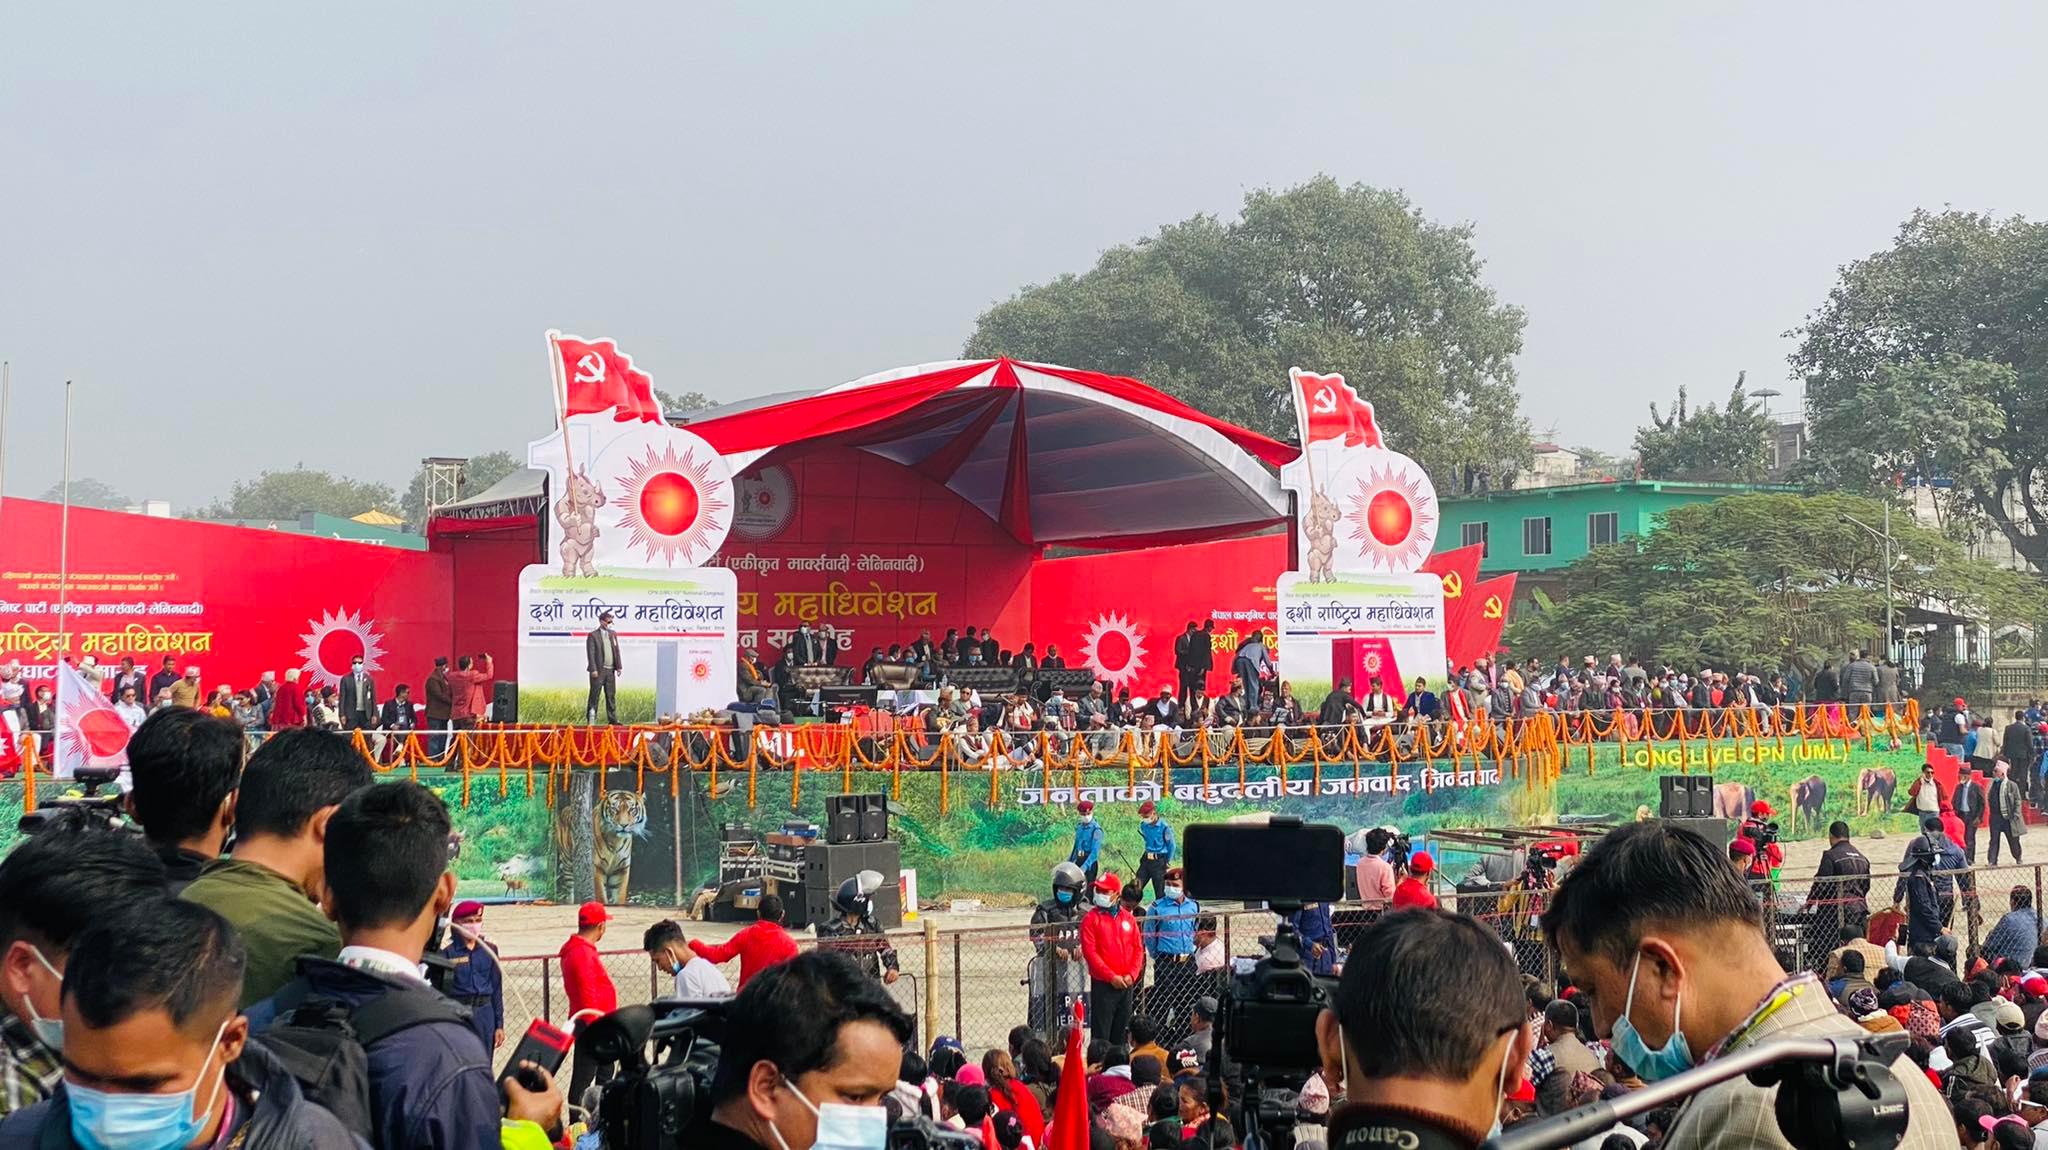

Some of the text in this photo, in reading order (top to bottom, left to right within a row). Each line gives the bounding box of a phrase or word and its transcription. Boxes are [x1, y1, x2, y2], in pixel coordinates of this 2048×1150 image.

[725, 553, 779, 576] (एकीकृत
[635, 597, 725, 623] महाधिवेशन
[774, 580, 937, 621] महाधिवेशन
[1317, 600, 1361, 625] राष्ट्रिय
[1366, 600, 1435, 622] महाधिवेशन
[81, 623, 214, 656] महाधिवेशन
[1623, 744, 1849, 767] LONG LIVE CPN (UML)
[1346, 1126, 1420, 1150] Canon
